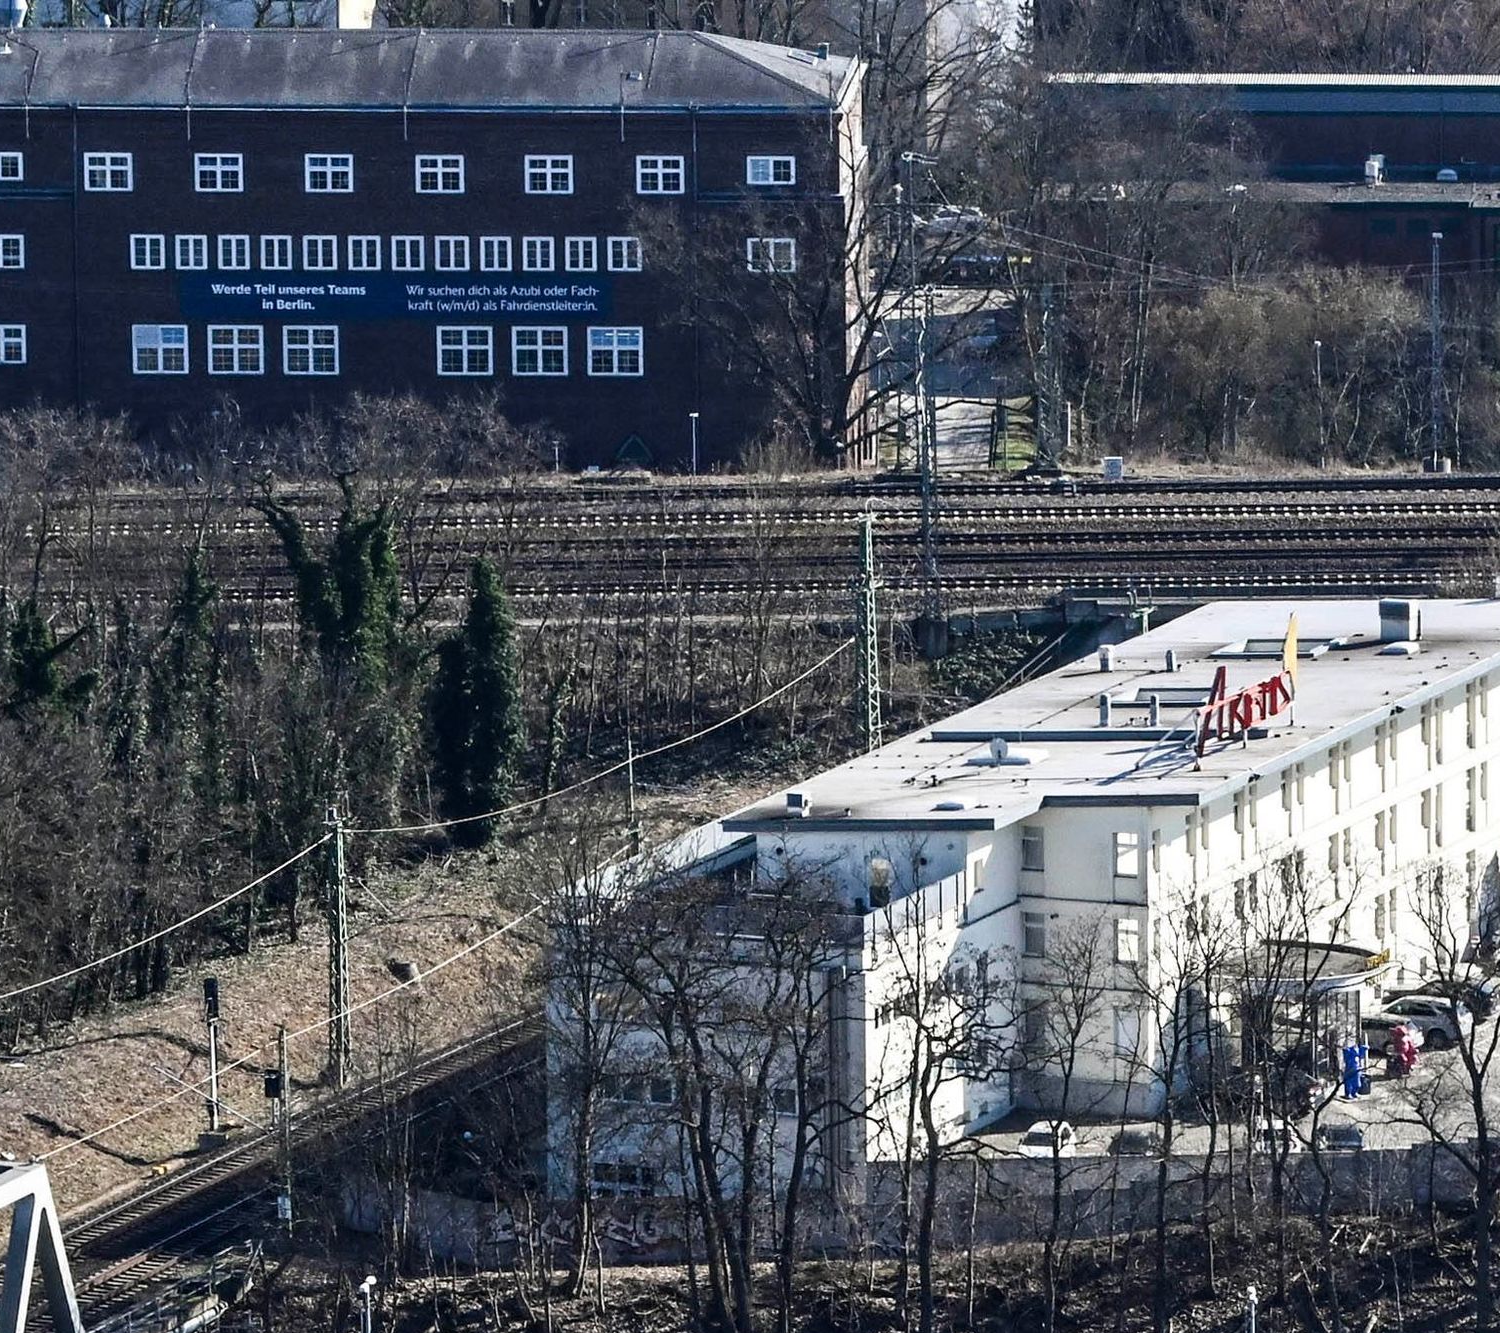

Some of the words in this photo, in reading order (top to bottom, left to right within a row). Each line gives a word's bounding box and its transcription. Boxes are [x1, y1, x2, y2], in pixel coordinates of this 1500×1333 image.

[211, 284, 252, 295] Werde
[254, 284, 276, 295] Teil
[278, 285, 325, 295] unseres
[327, 284, 367, 295] Teams
[405, 284, 425, 296] Wir
[427, 285, 466, 297] suchen
[467, 285, 491, 297] dich
[492, 285, 508, 297] als
[510, 286, 542, 297] Azubi
[543, 286, 568, 297] oder
[571, 286, 601, 297] Fach-
[261, 298, 274, 310] in
[276, 298, 316, 311] Berlin.
[407, 300, 434, 312] kraft
[436, 300, 481, 313] (w/m/d)
[482, 300, 498, 311] als
[500, 300, 599, 312] Fahrdienstleiter:in.
